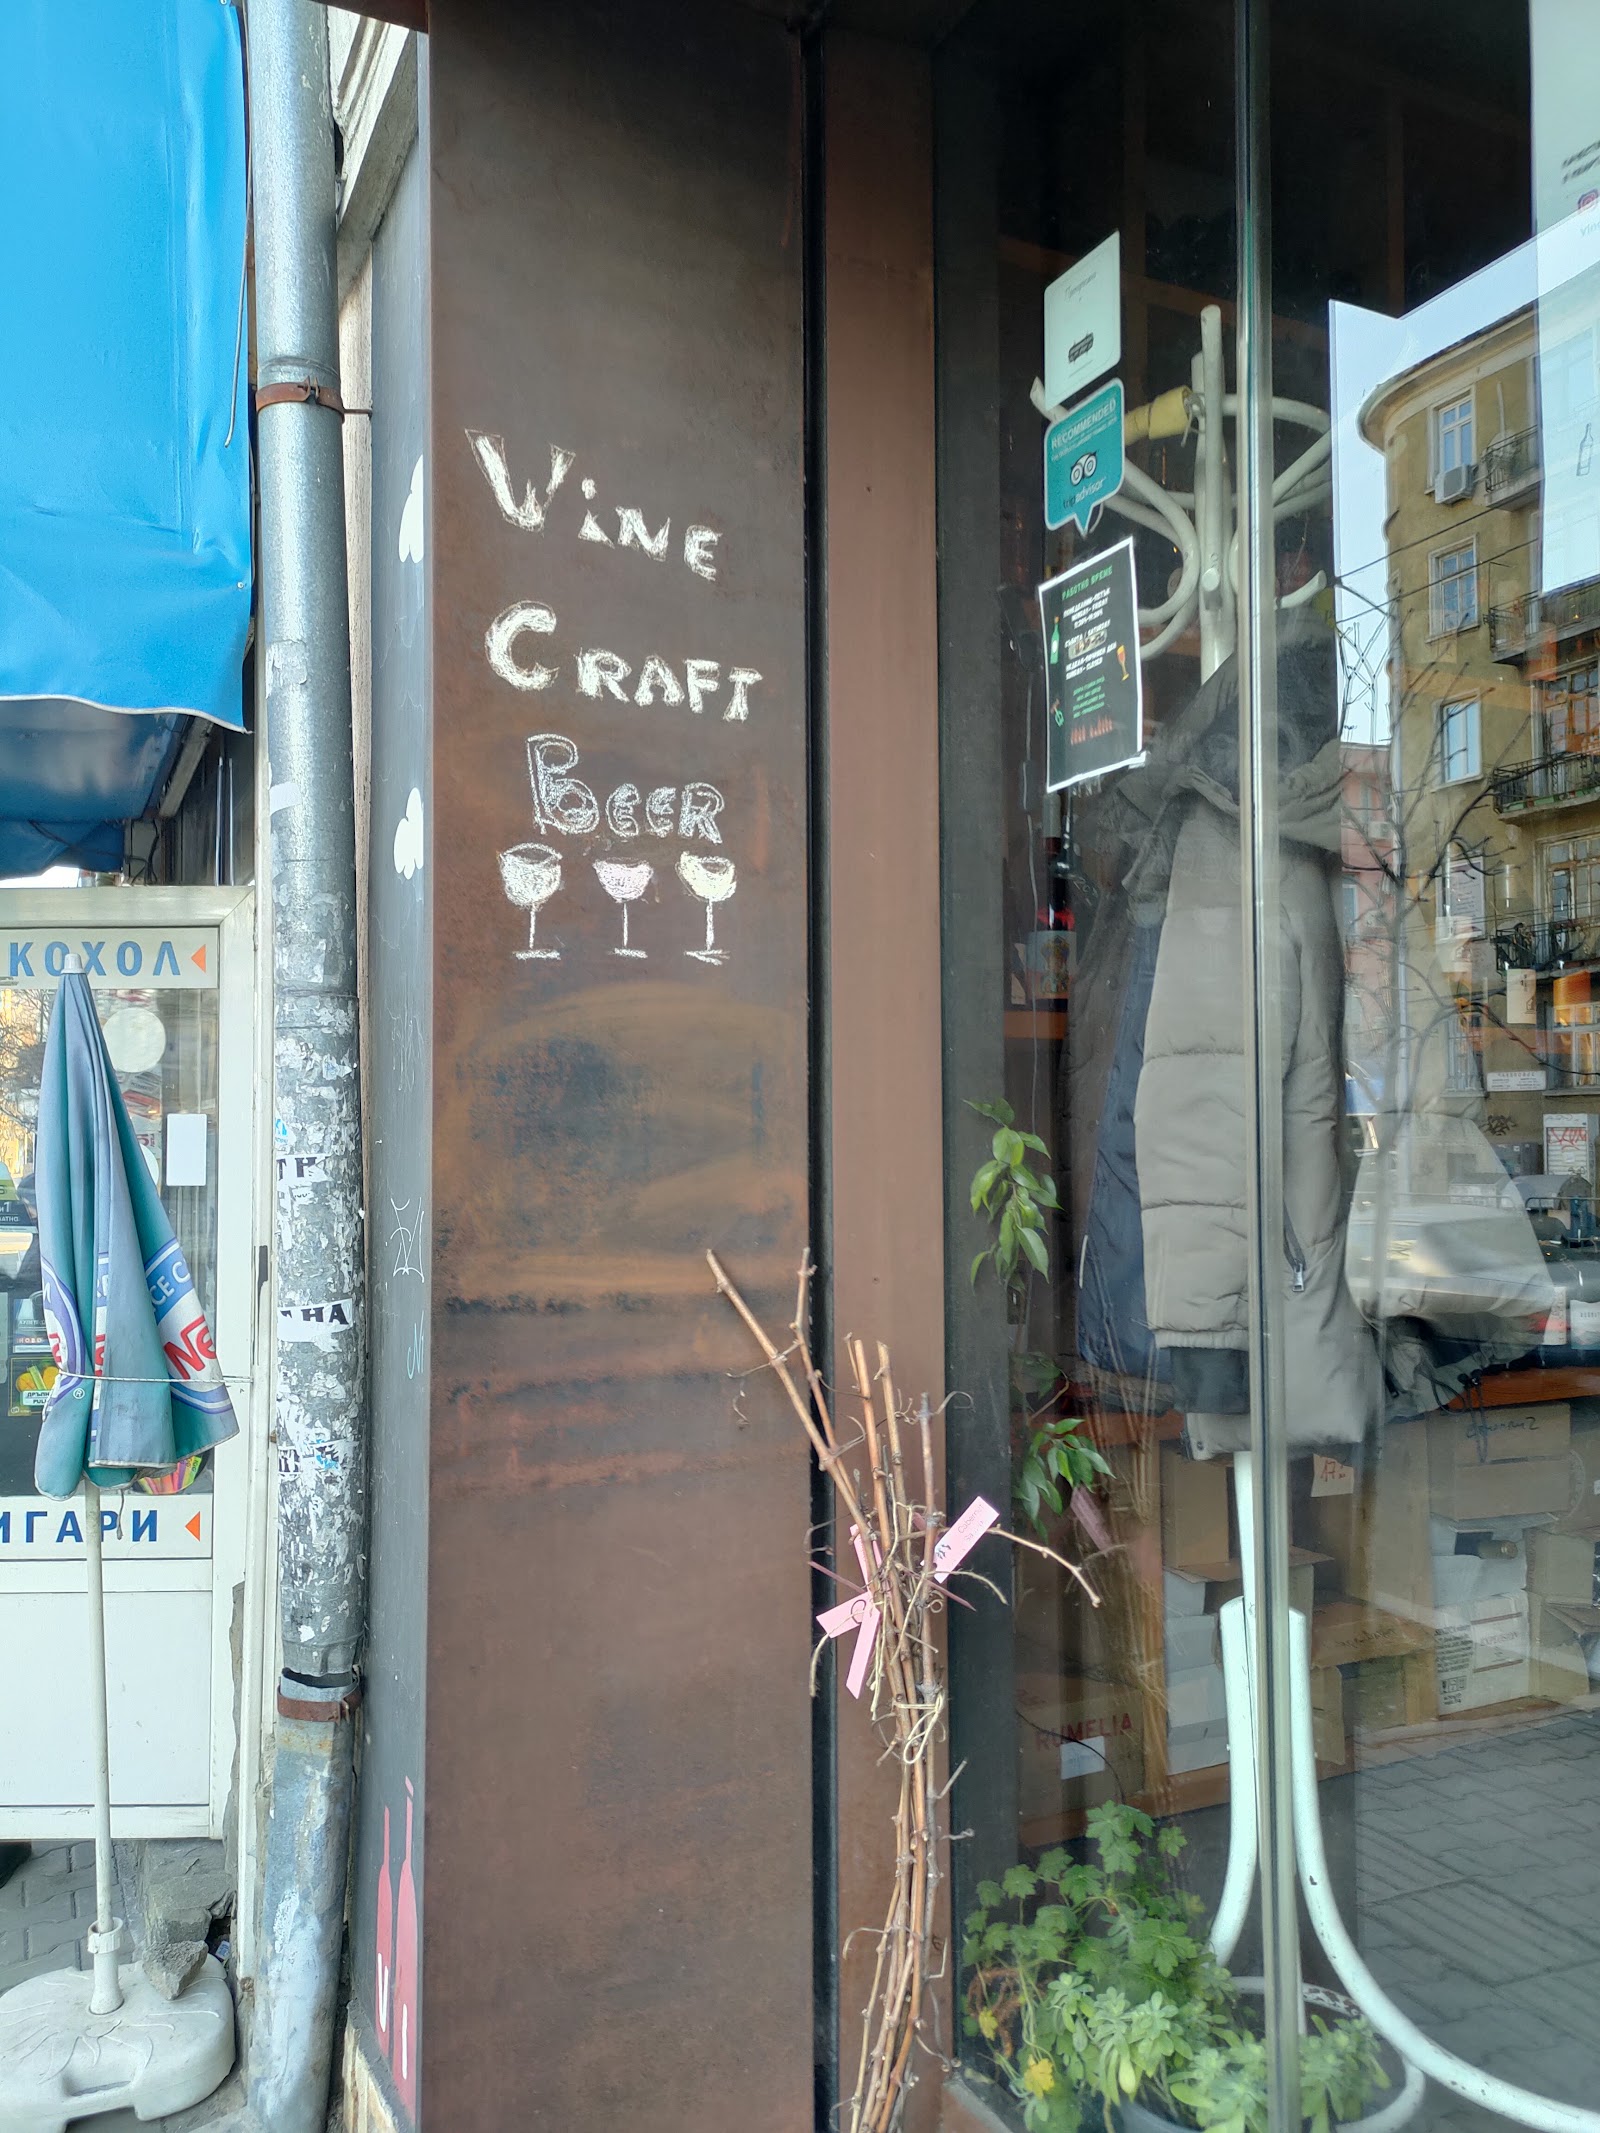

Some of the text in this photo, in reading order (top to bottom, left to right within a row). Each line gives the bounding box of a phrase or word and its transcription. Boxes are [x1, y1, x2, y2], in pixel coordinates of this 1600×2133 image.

[1051, 398, 1117, 450] RECOMMENDED
[1063, 476, 1106, 509] tripadvisor
[1062, 565, 1114, 601] РАБОТНО ВРЕМЕ
[485, 599, 764, 723] CRAFT
[9, 940, 181, 977] КОХОЛ
[1034, 1712, 1132, 1752] RUMELIA
